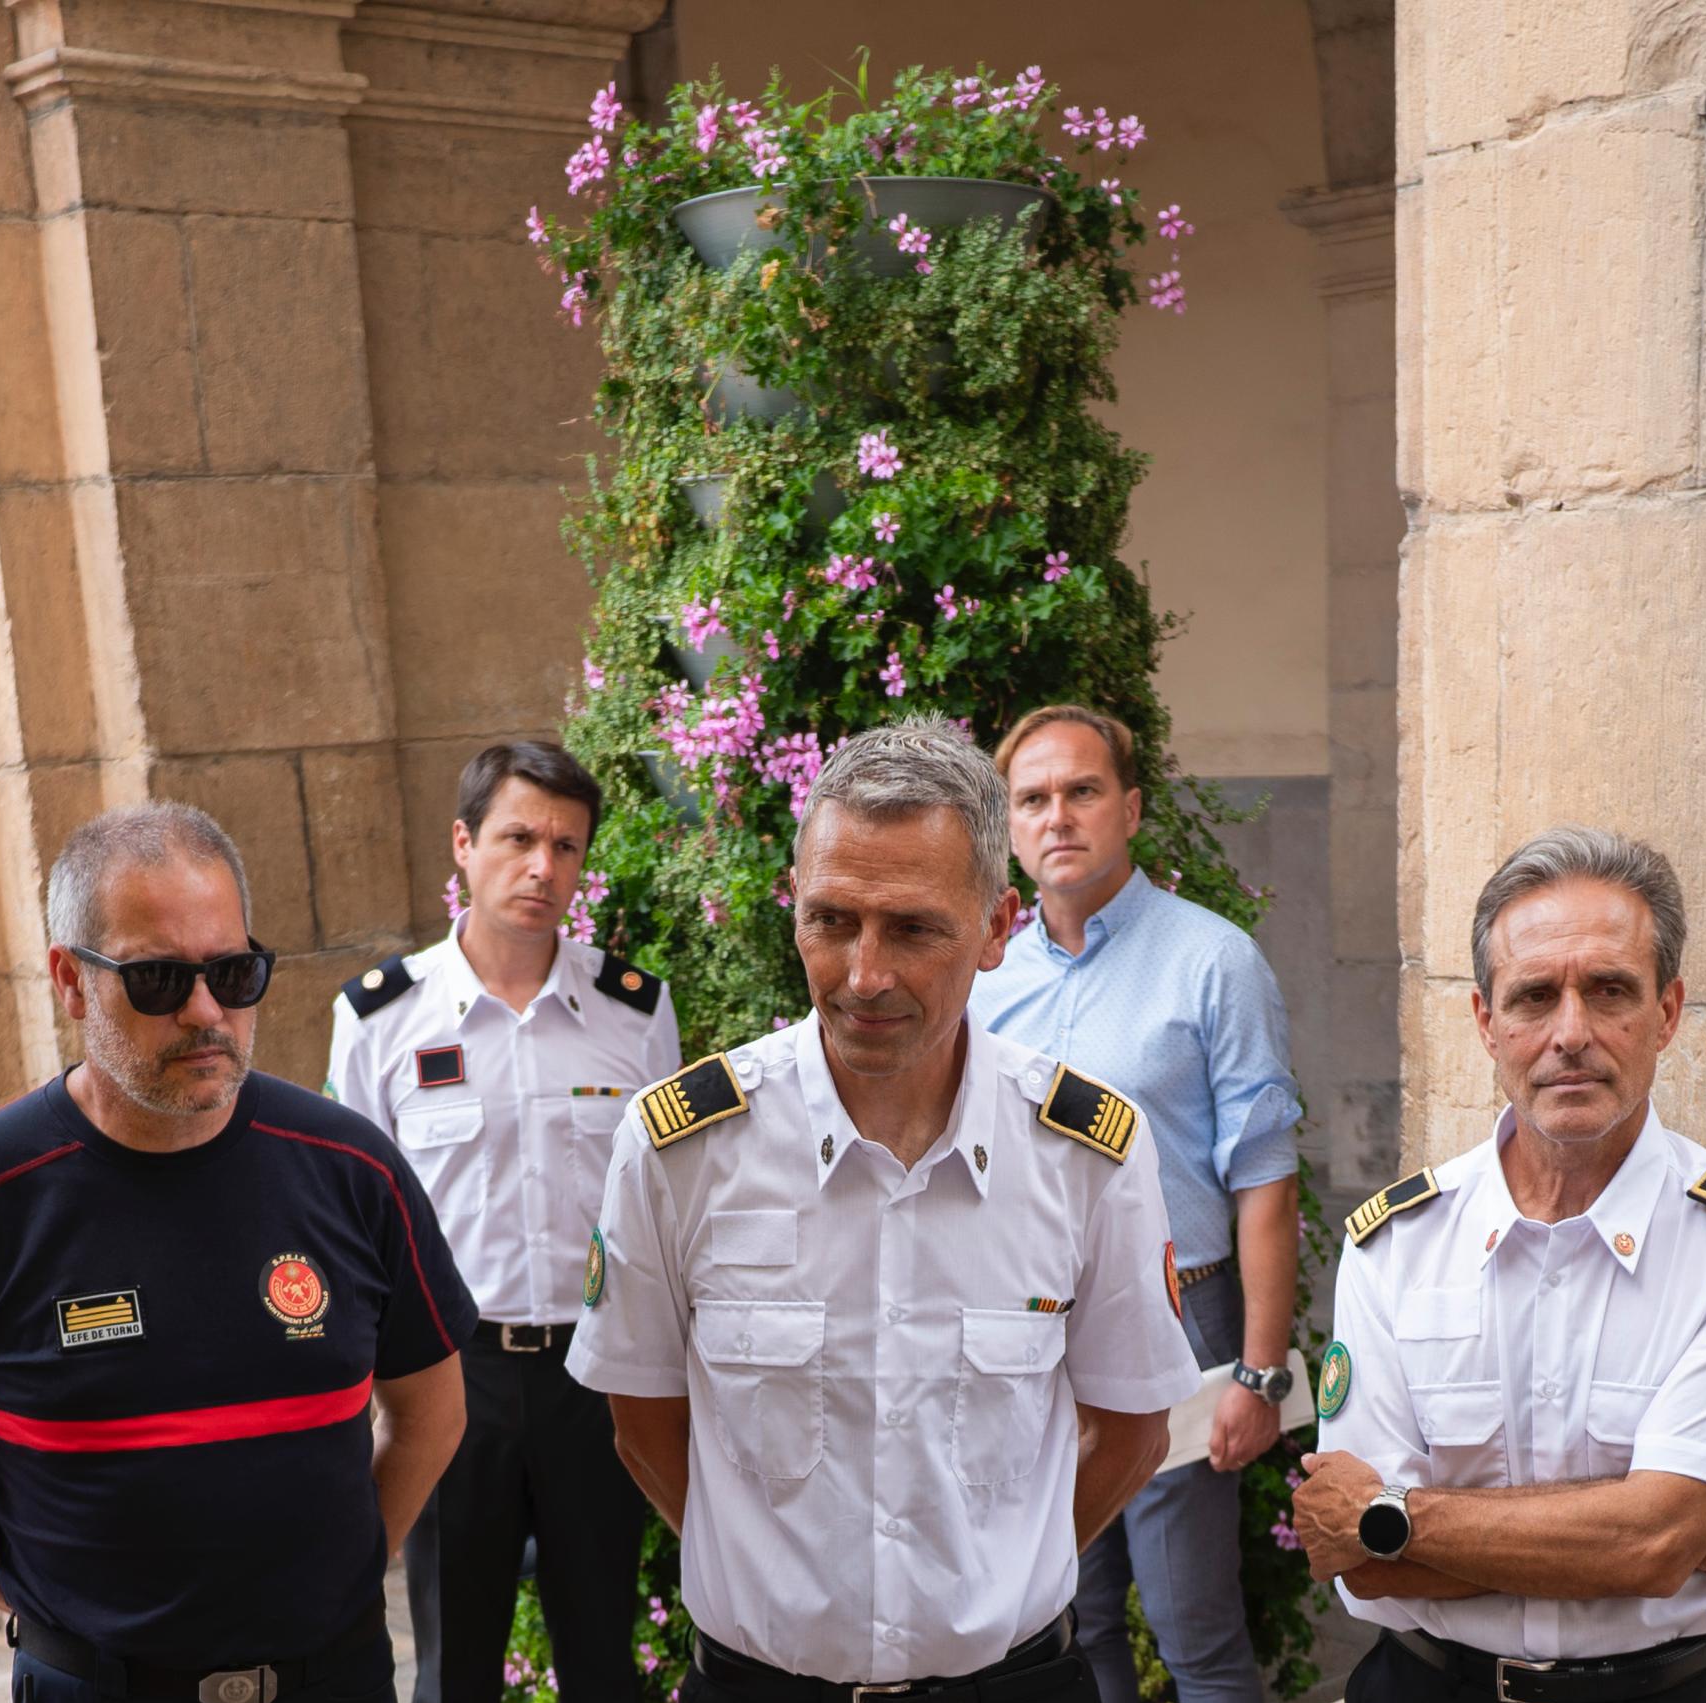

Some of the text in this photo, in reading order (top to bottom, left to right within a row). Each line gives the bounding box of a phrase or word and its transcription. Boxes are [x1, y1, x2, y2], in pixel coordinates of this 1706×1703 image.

[66, 1324, 140, 1344] JEFE DE TURNO
